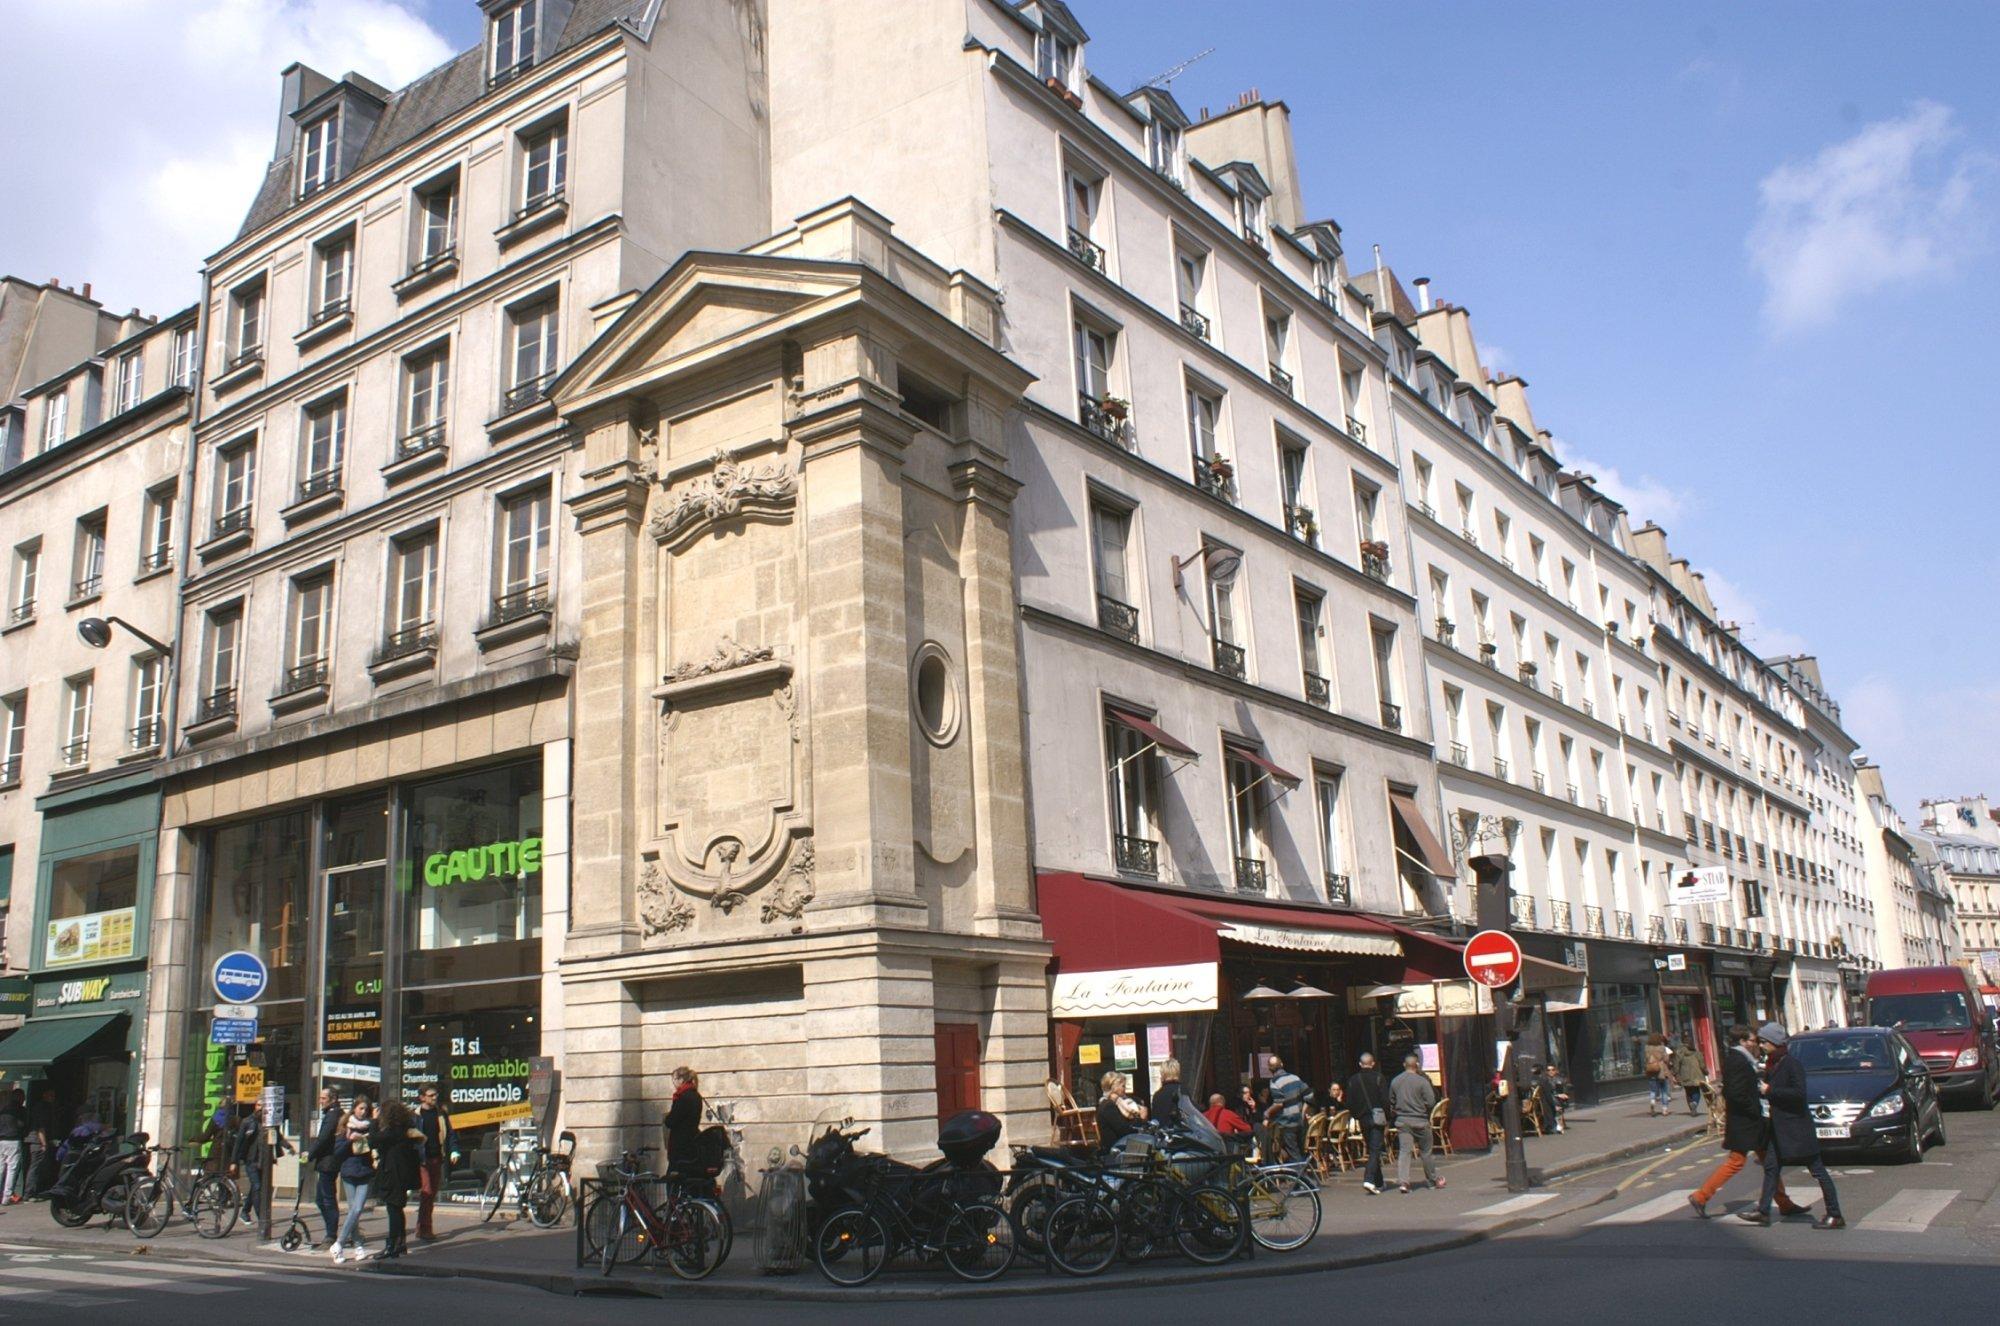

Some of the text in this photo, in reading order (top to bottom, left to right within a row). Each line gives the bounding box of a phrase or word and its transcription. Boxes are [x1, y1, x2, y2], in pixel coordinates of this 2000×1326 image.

[424, 837, 542, 887] GAUTIE
[58, 977, 111, 1004] SUBWAY
[1061, 975, 1194, 1000] La Fontaine
[353, 1019, 382, 1029] MEUBLA
[403, 1044, 429, 1056] Séjours
[451, 1037, 480, 1055] Et si
[403, 1060, 426, 1069] Salons
[451, 1059, 530, 1079] on meubla
[402, 1073, 438, 1083] Chambres
[402, 1088, 419, 1098] Dres
[450, 1083, 521, 1103] ensemble
